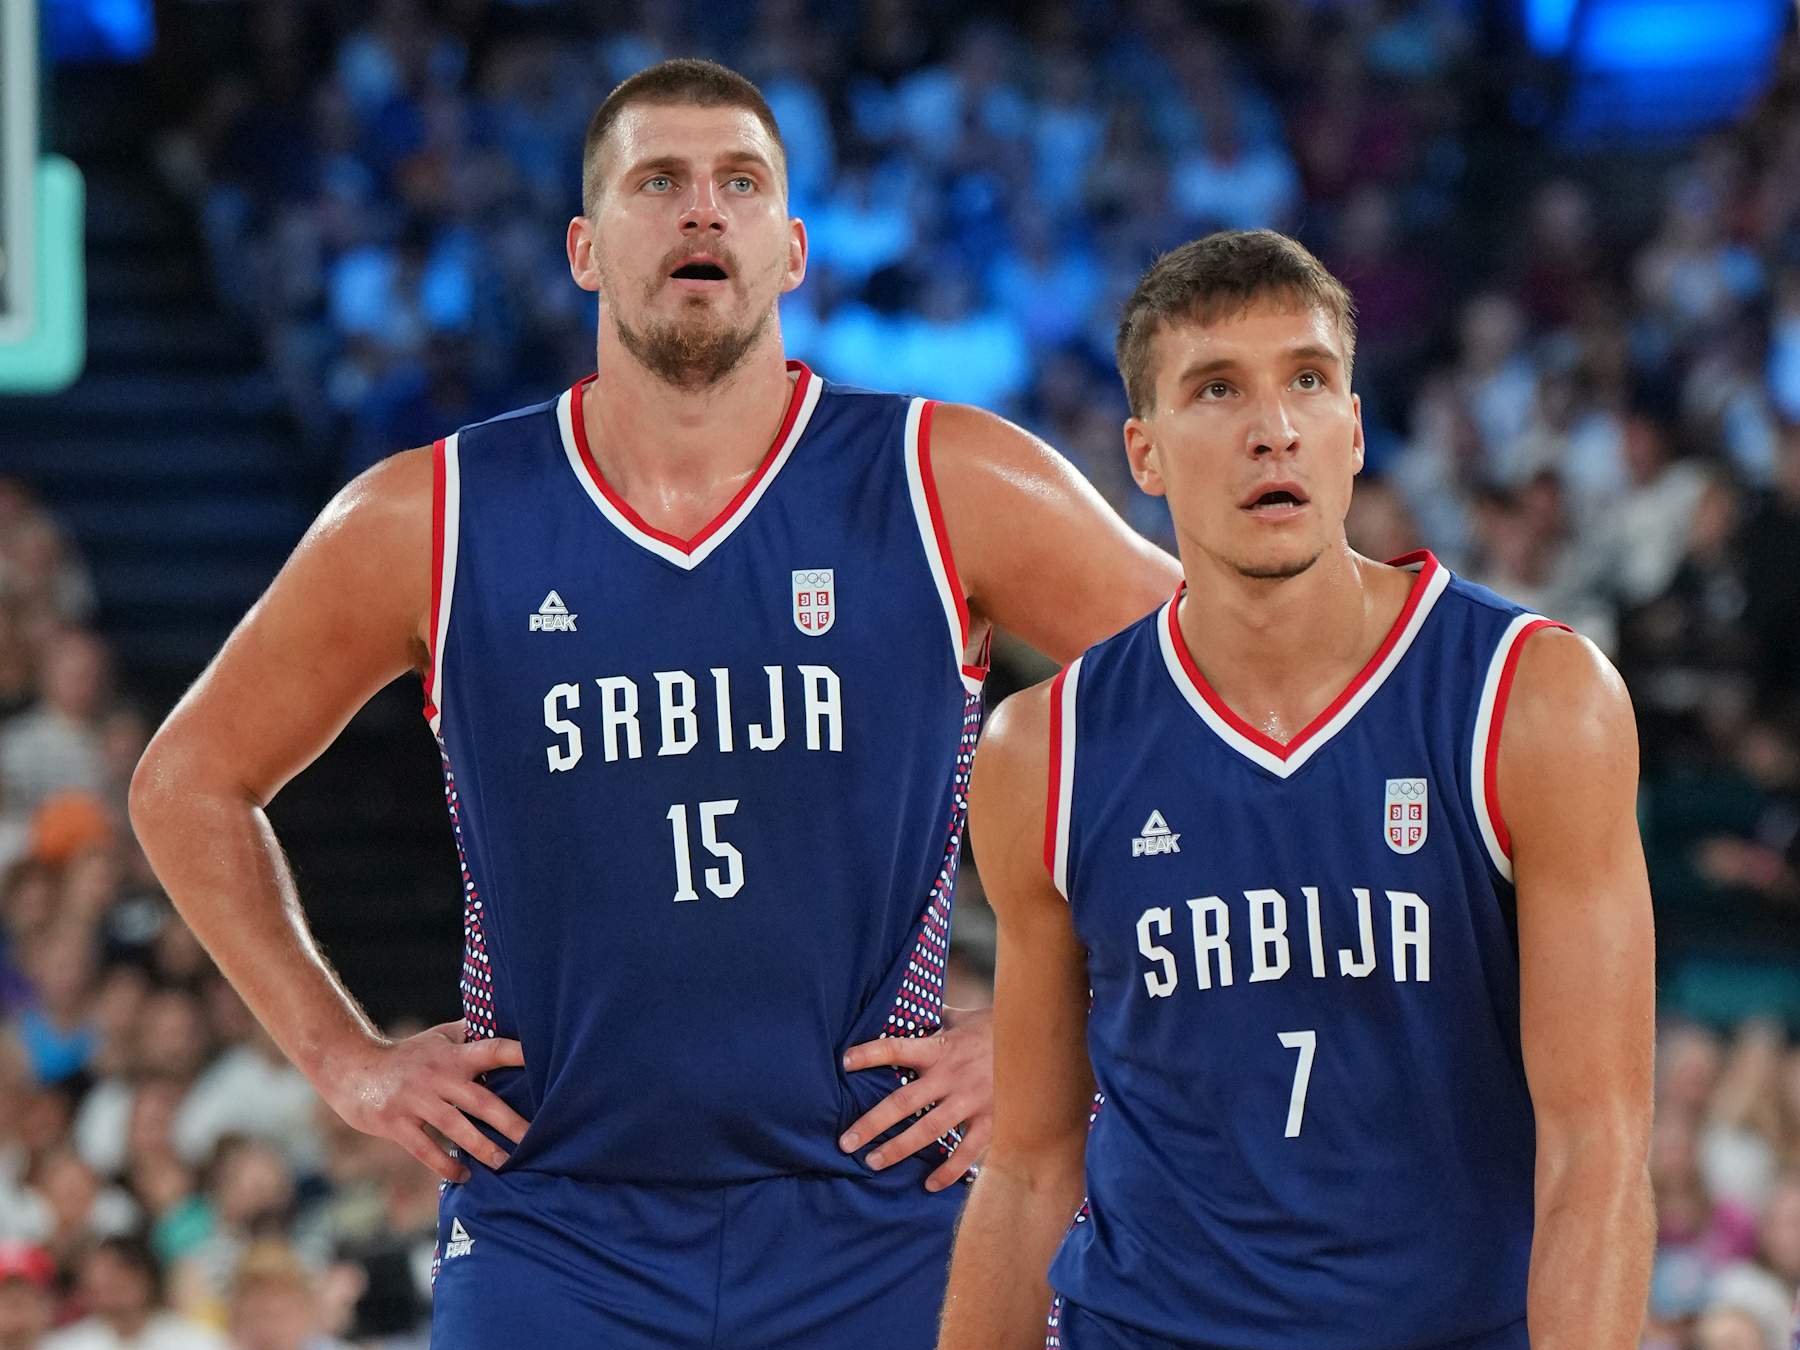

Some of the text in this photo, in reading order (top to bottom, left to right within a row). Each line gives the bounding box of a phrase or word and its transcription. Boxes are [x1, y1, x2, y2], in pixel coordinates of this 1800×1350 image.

[528, 613, 578, 632] PEAK
[543, 664, 843, 773] SRBIJA
[665, 799, 745, 902] 15
[1132, 833, 1183, 857] PEAK
[1136, 886, 1431, 999] SRBIJA
[1276, 1030, 1317, 1138] 7
